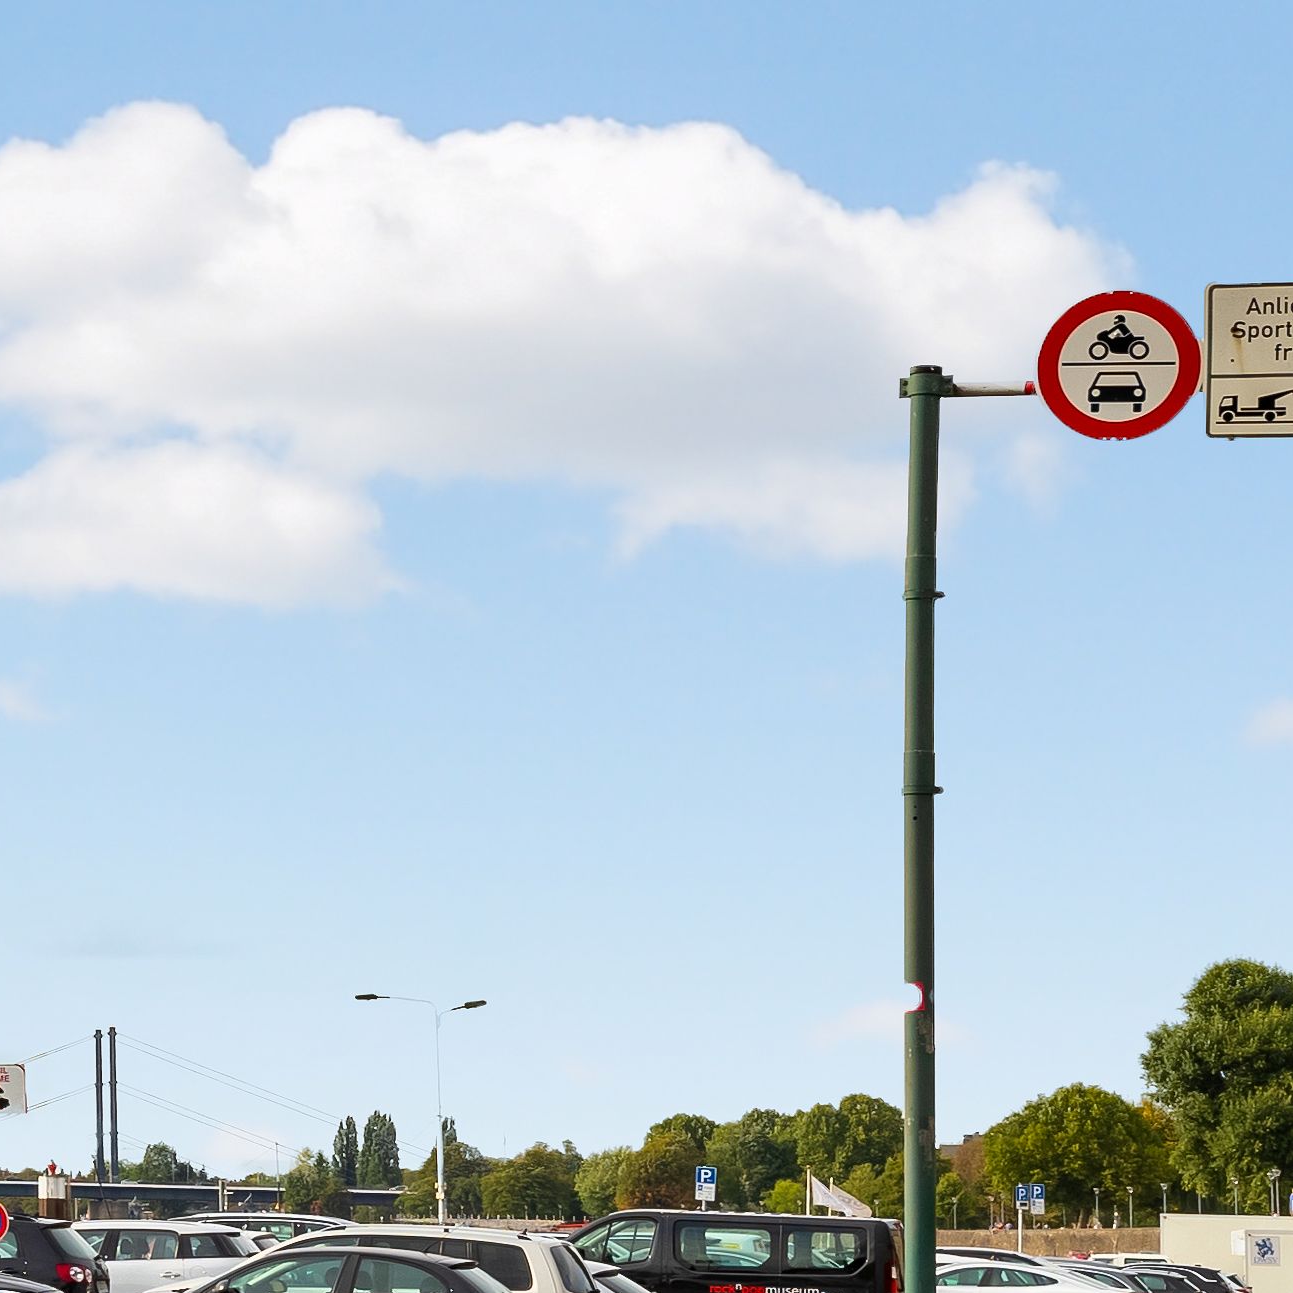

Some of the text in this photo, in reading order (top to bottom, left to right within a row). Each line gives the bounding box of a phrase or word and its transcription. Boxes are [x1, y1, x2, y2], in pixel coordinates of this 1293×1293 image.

[1246, 296, 1293, 315] Anli
[1231, 321, 1292, 343] Sport
[700, 1169, 712, 1183] P
